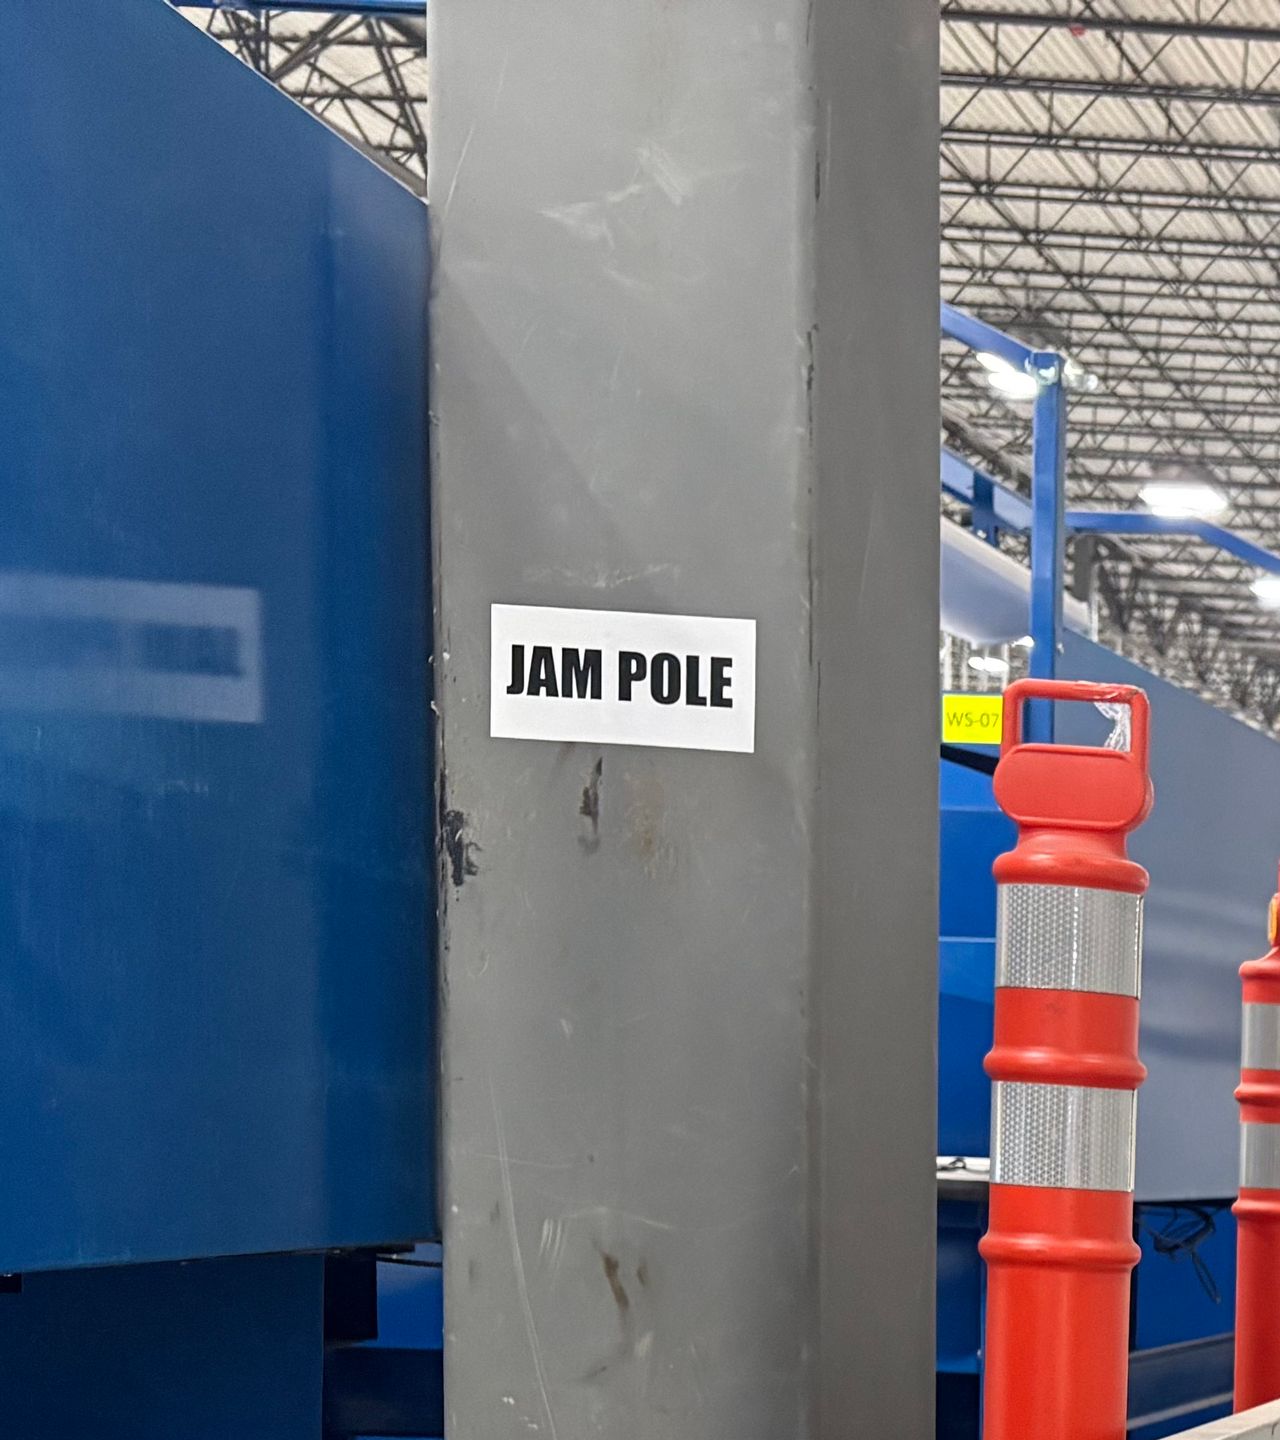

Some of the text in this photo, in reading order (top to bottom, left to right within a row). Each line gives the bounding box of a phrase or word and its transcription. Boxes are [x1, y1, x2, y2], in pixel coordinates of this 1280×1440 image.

[506, 644, 733, 709] JAM POLE
[946, 712, 1000, 728] WS-07
